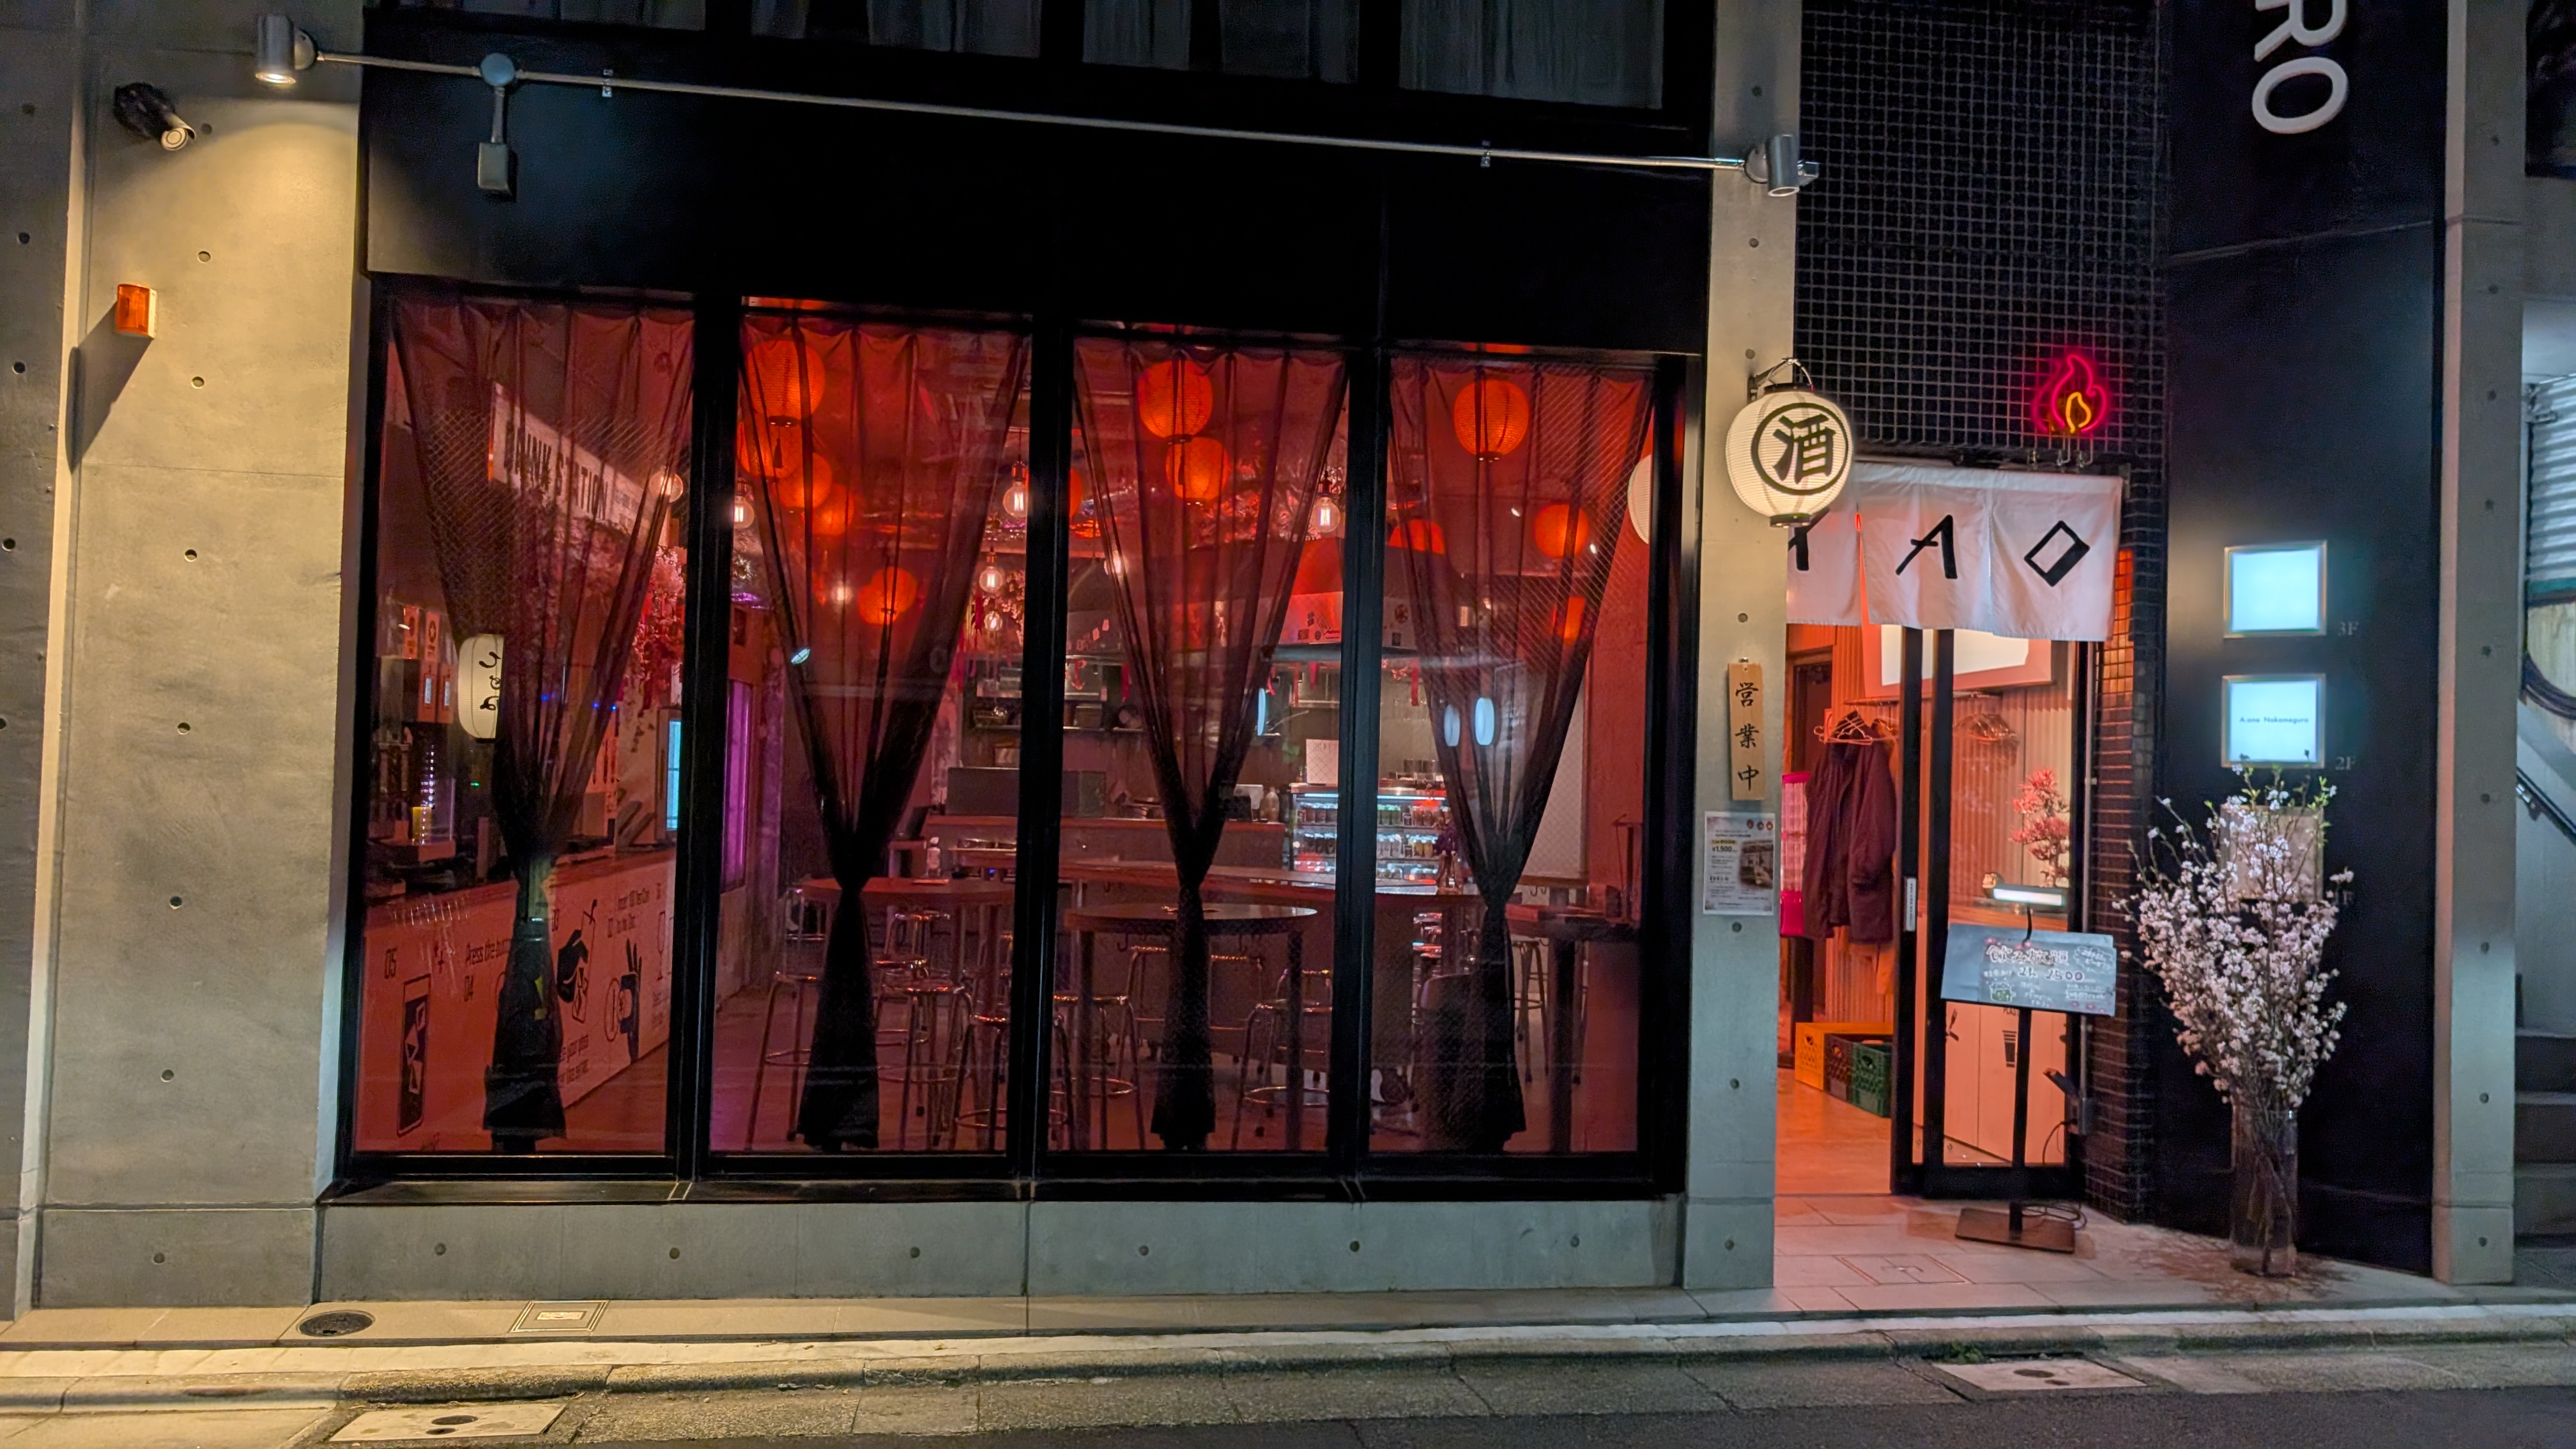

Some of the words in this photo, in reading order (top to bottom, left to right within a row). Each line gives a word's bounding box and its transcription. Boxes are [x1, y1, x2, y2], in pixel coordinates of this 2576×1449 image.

[1772, 413, 1837, 484] 酒
[2338, 621, 2359, 636] 3F
[2264, 716, 2309, 724] Nakameguro
[1735, 682, 1759, 792] 営業中
[2334, 756, 2356, 770] 2F
[384, 946, 397, 979] 05
